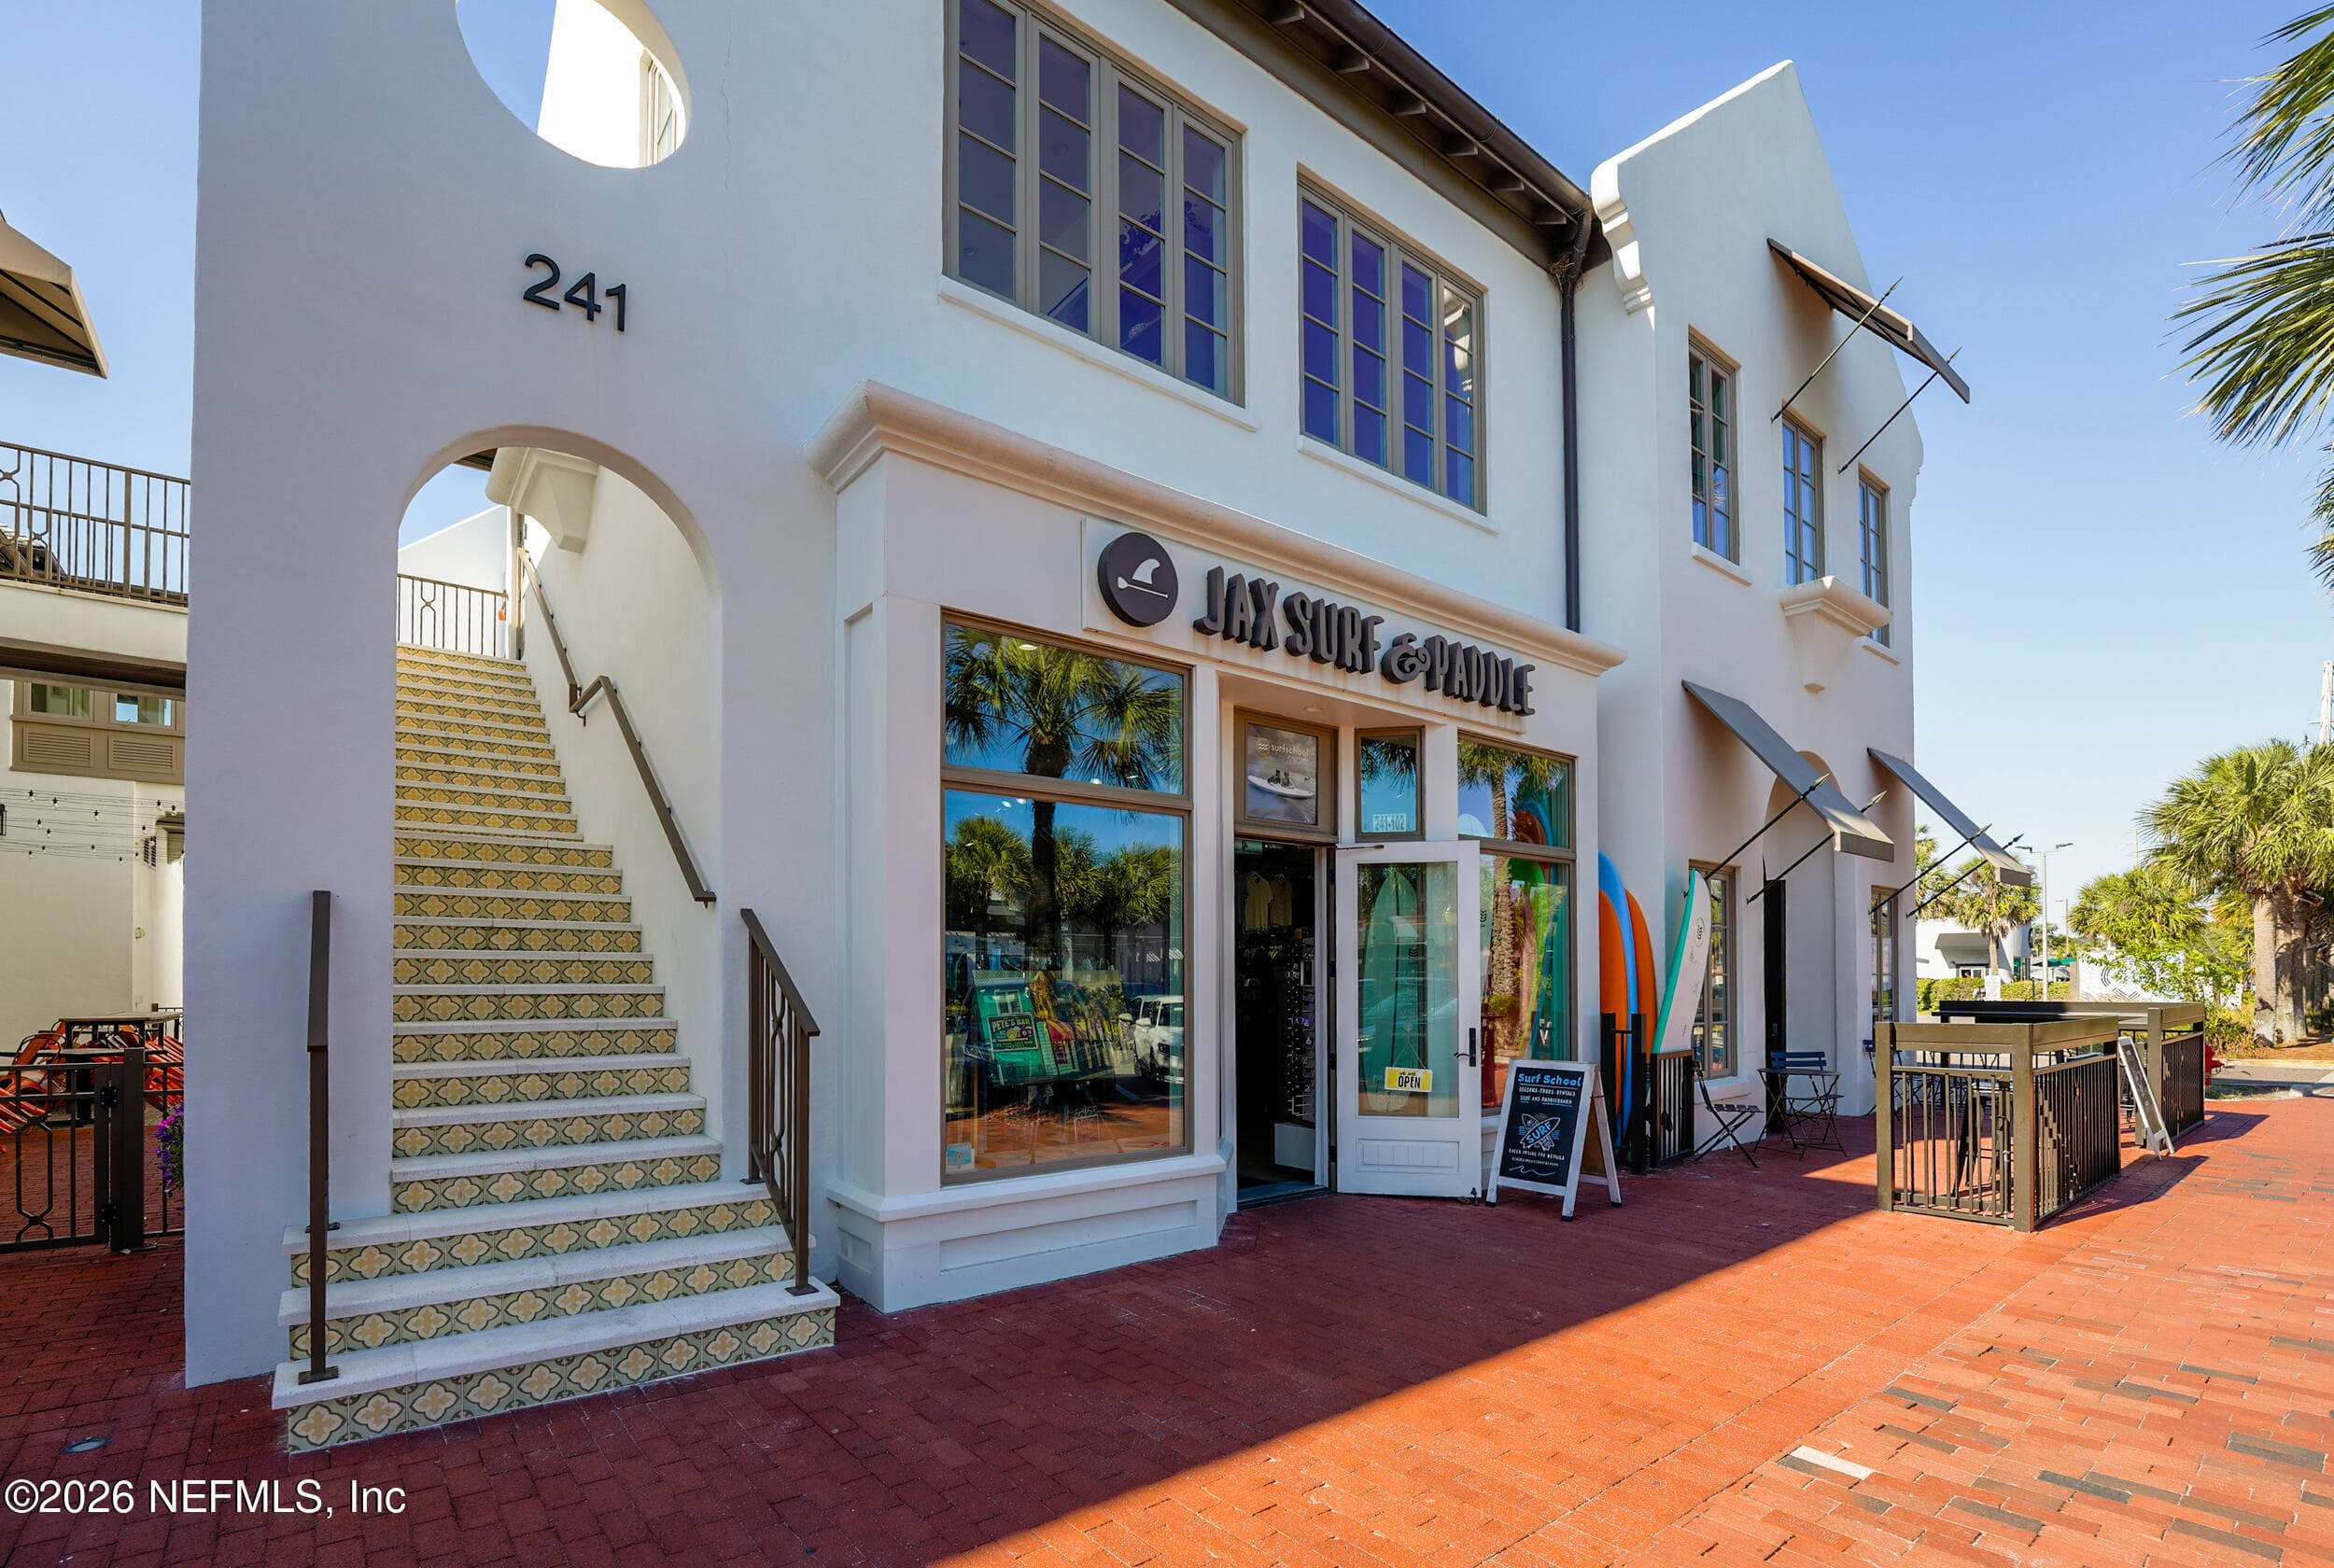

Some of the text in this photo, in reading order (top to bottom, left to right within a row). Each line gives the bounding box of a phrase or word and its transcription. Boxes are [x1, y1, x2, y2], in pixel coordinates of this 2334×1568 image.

[523, 253, 626, 332] 241
[1193, 566, 1536, 716] JAX SURF & PADDLE
[991, 1018, 1016, 1032] PETE'S
[1398, 1075, 1421, 1088] OPEN
[1517, 1073, 1582, 1087] Surf School
[1526, 1121, 1552, 1143] SURF
